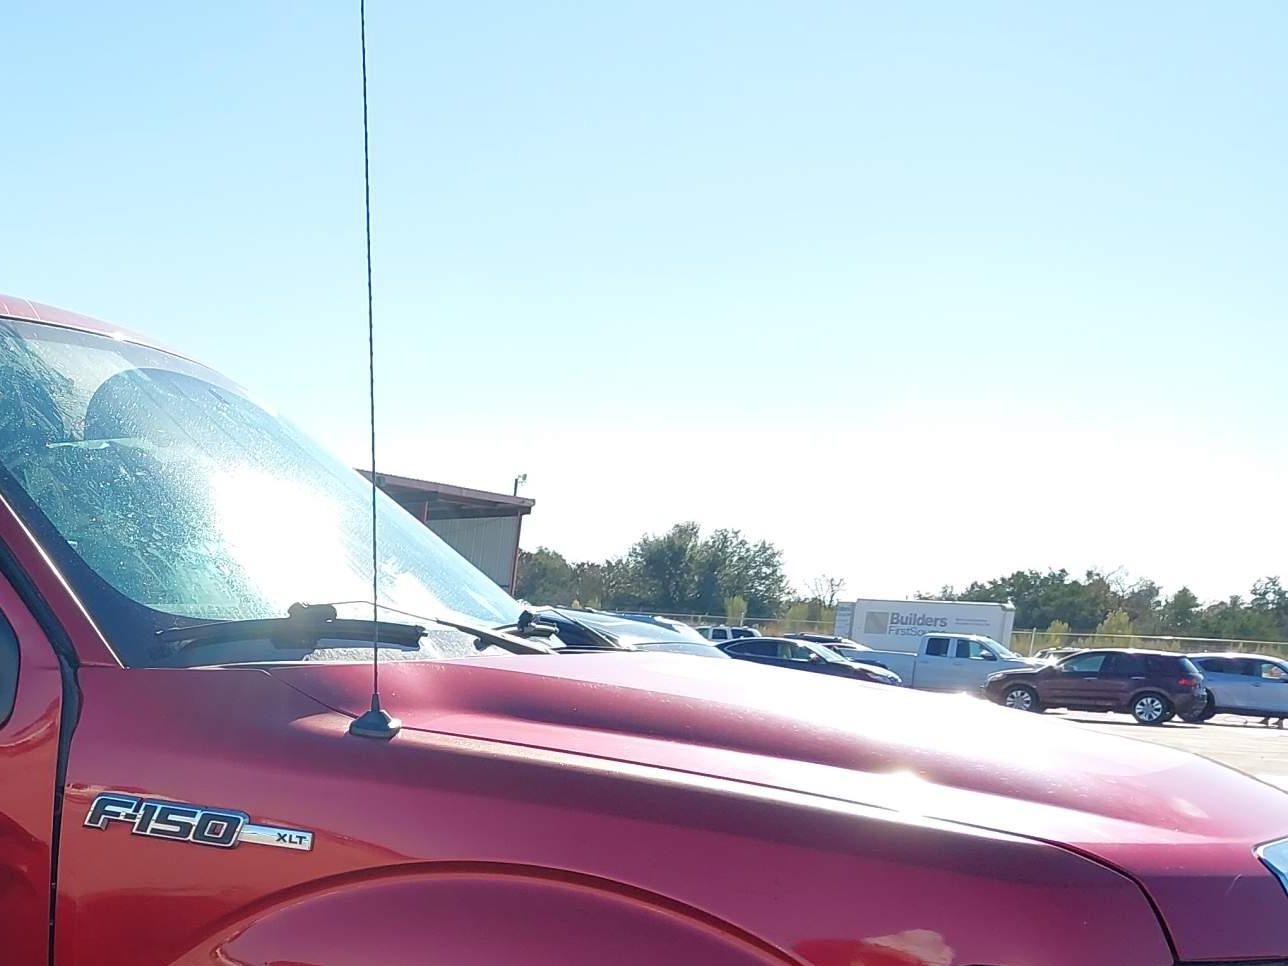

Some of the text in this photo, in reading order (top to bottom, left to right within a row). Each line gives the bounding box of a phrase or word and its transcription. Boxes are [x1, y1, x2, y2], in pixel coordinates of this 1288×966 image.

[889, 612, 948, 627] Builders
[84, 793, 309, 847] F-150 XLT
